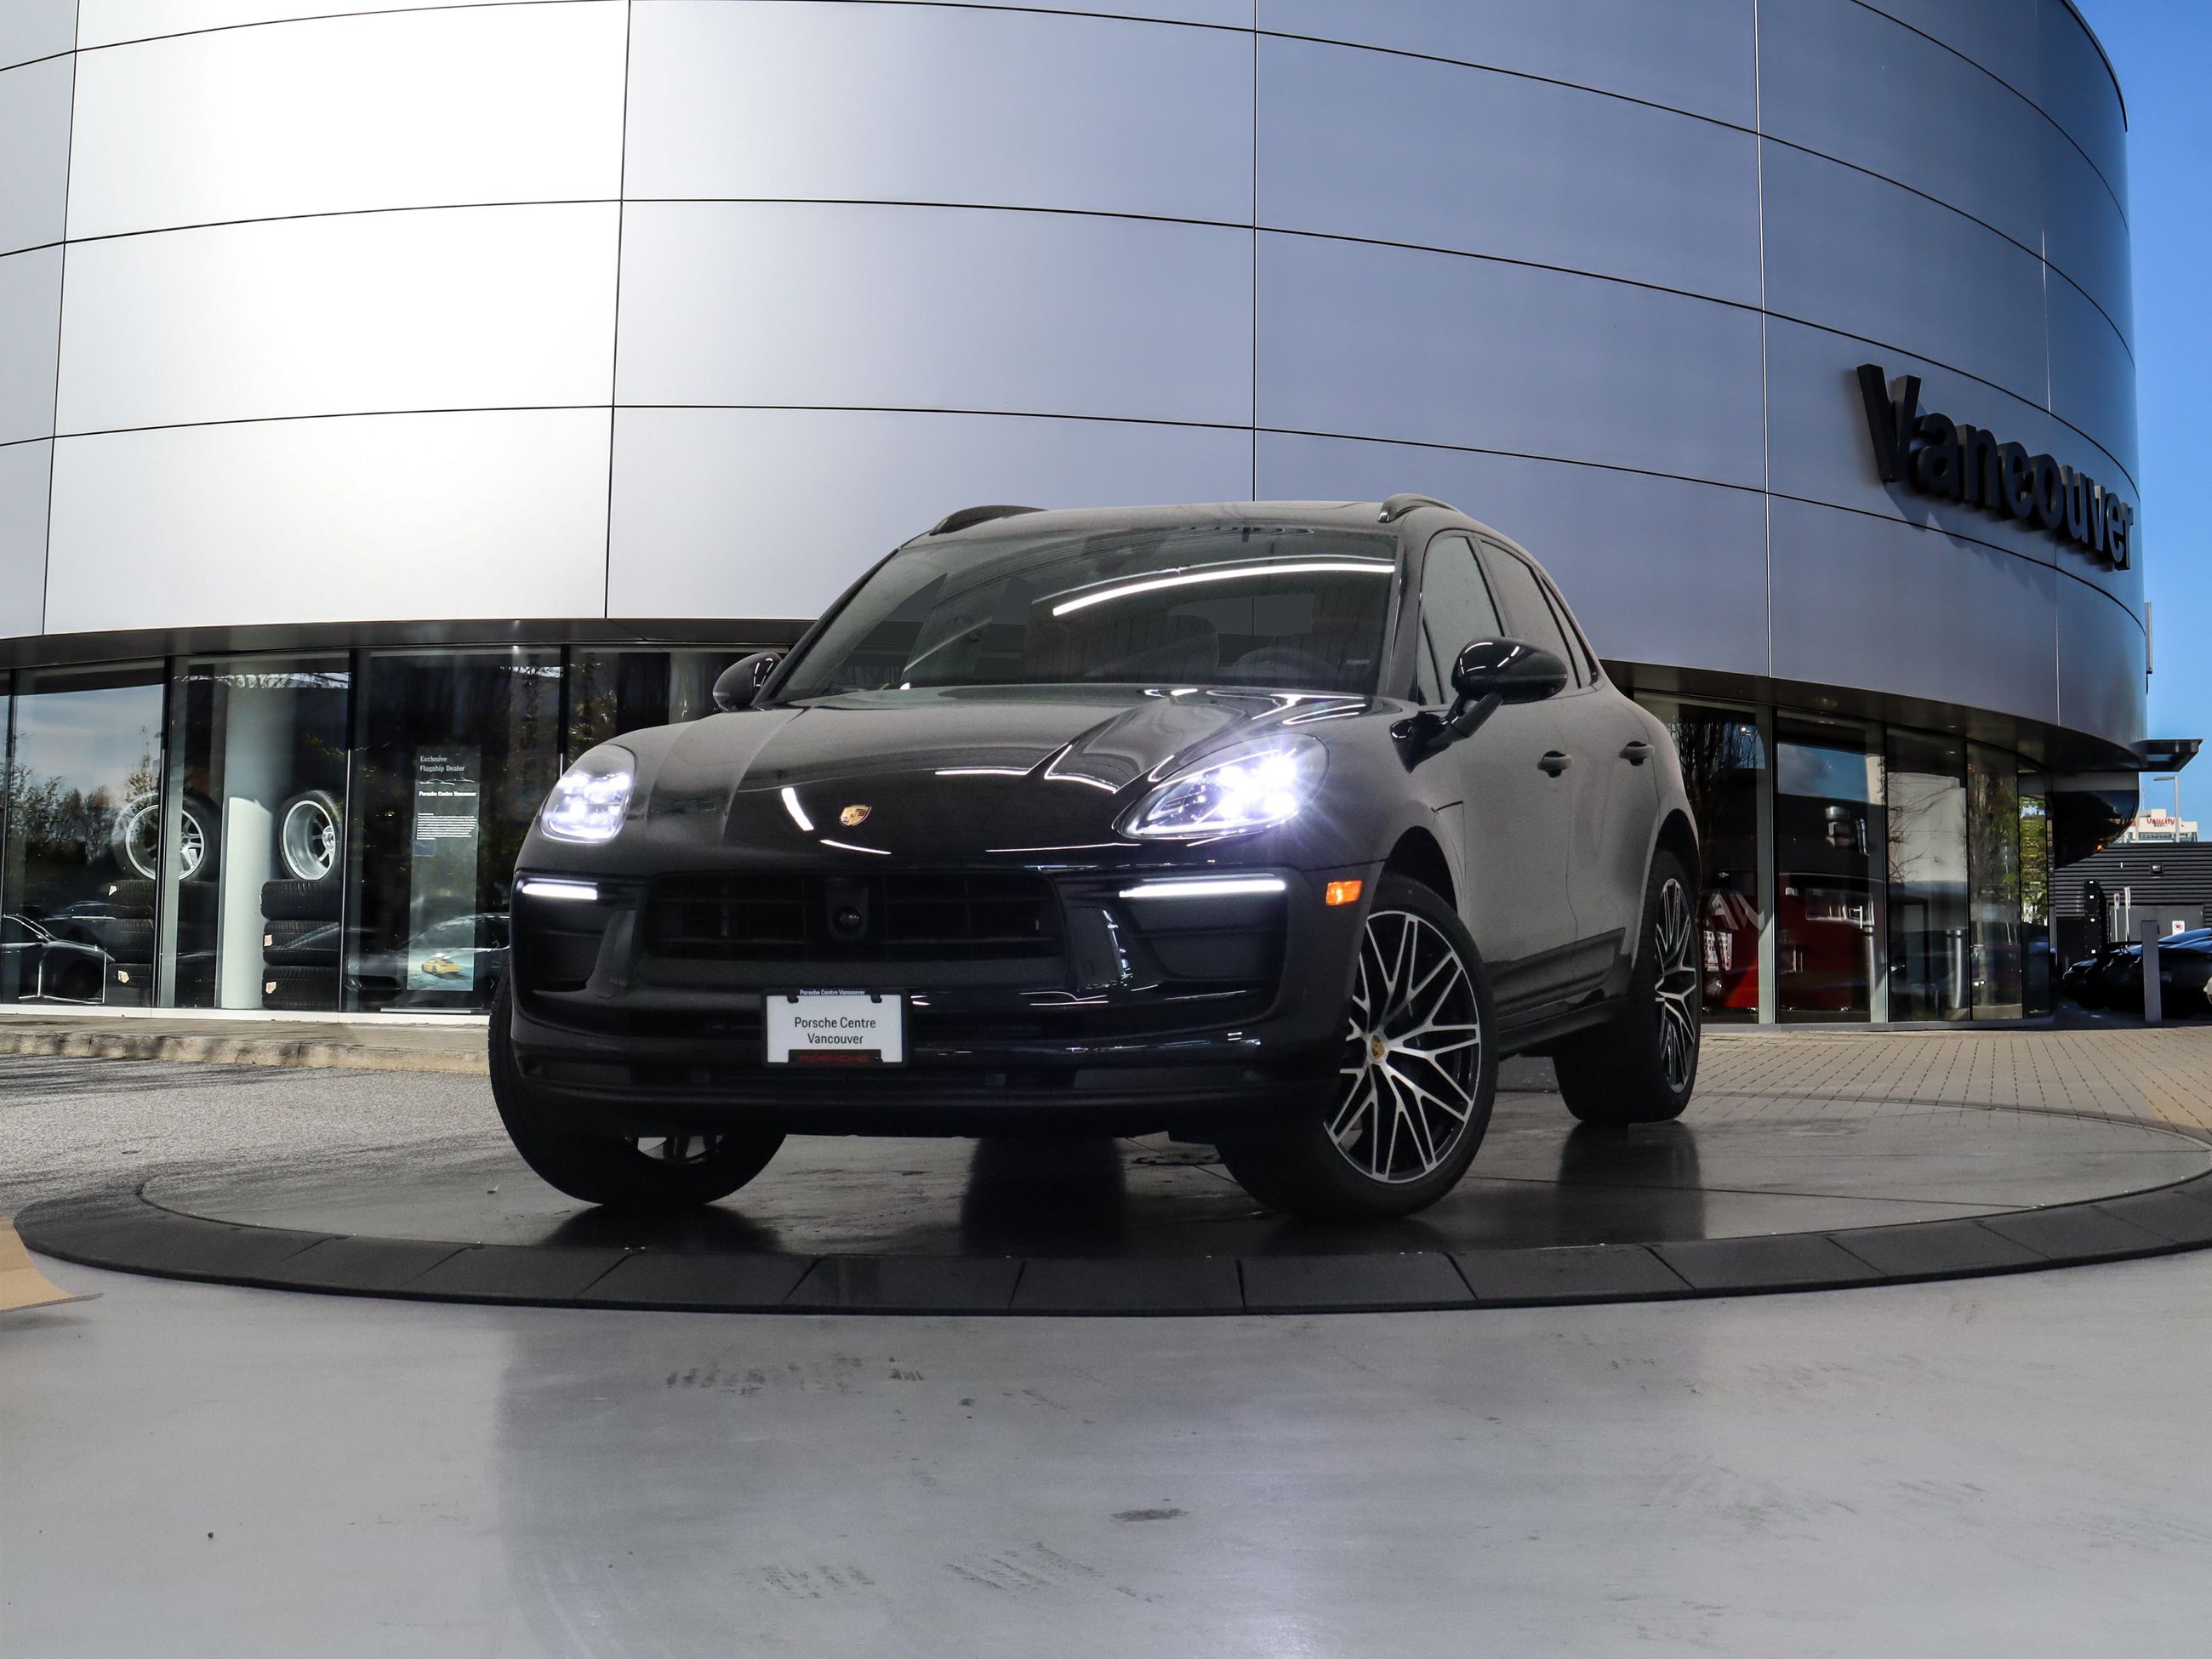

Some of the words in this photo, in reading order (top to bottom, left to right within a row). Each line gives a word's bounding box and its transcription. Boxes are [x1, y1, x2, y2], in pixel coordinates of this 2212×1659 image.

[1856, 363, 2135, 571] Vancouver
[794, 1017, 837, 1029] Porsche
[840, 1017, 876, 1029] Centre
[807, 1033, 864, 1045] Vancouver
